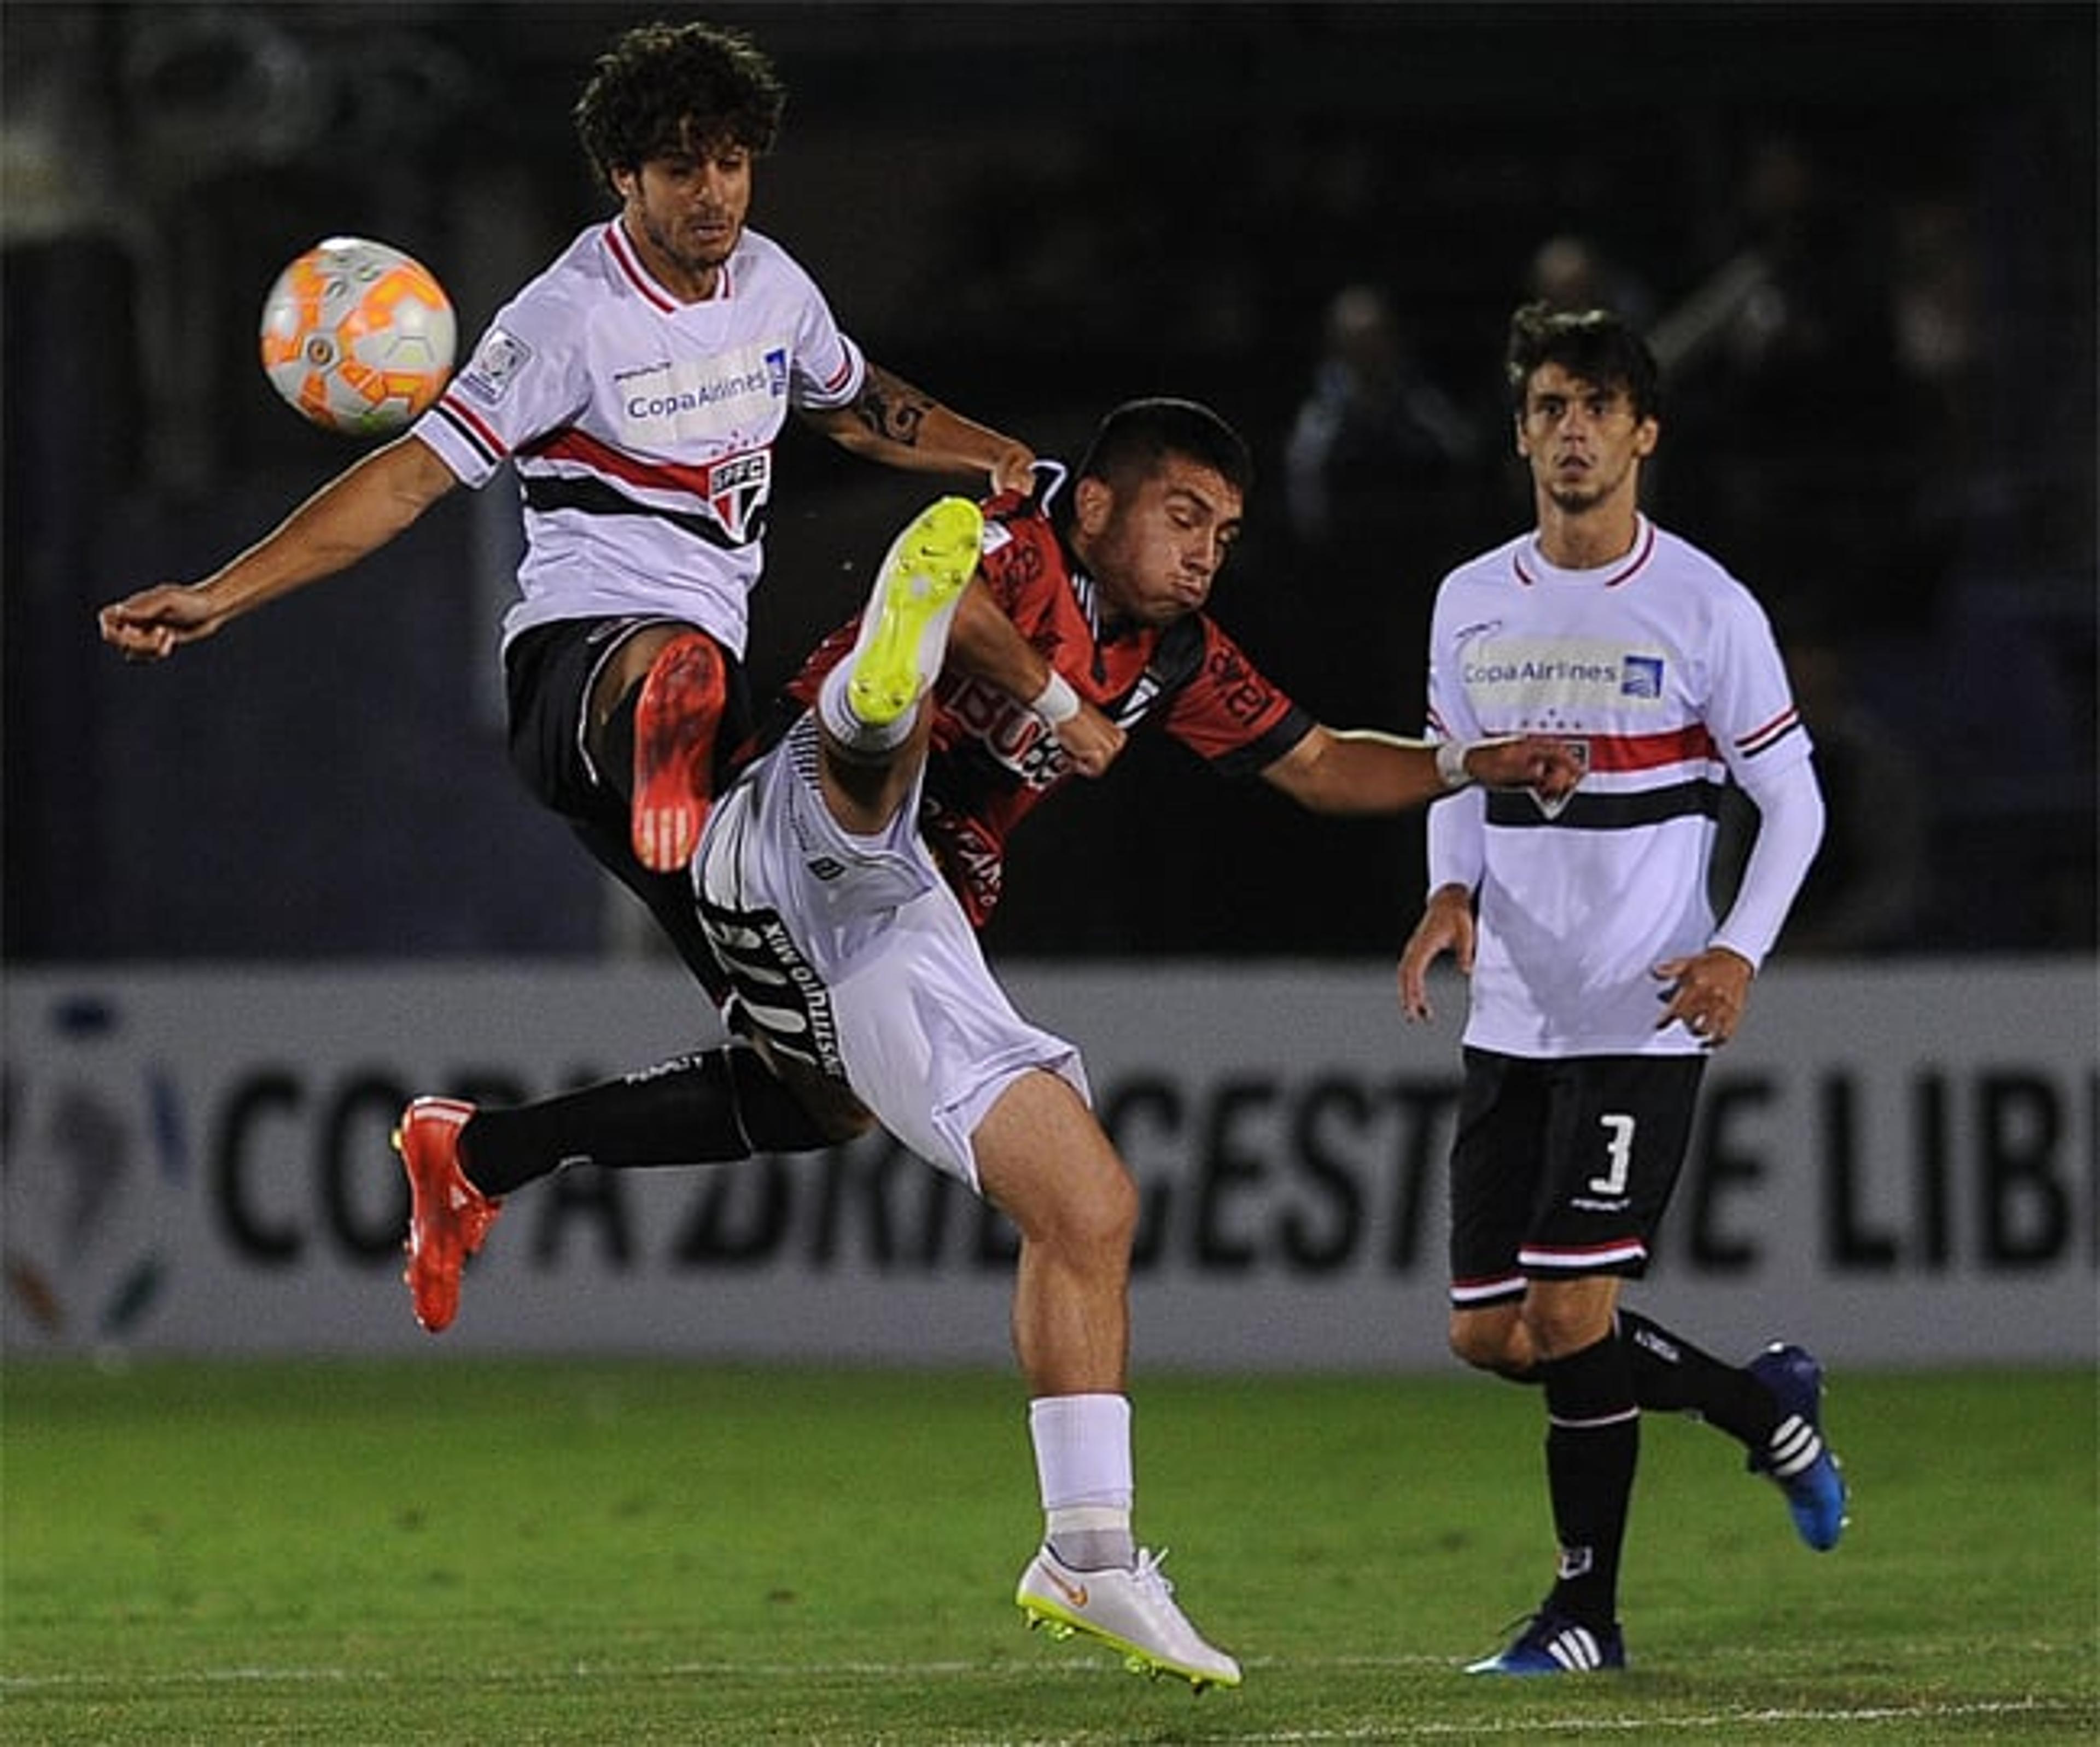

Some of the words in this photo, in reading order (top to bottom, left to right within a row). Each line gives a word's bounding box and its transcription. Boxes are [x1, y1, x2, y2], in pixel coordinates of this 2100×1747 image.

[761, 921, 801, 965] MIX
[216, 1071, 632, 1266] COA
[1820, 1071, 2099, 1271] LIB
[1589, 1114, 1635, 1194] 3
